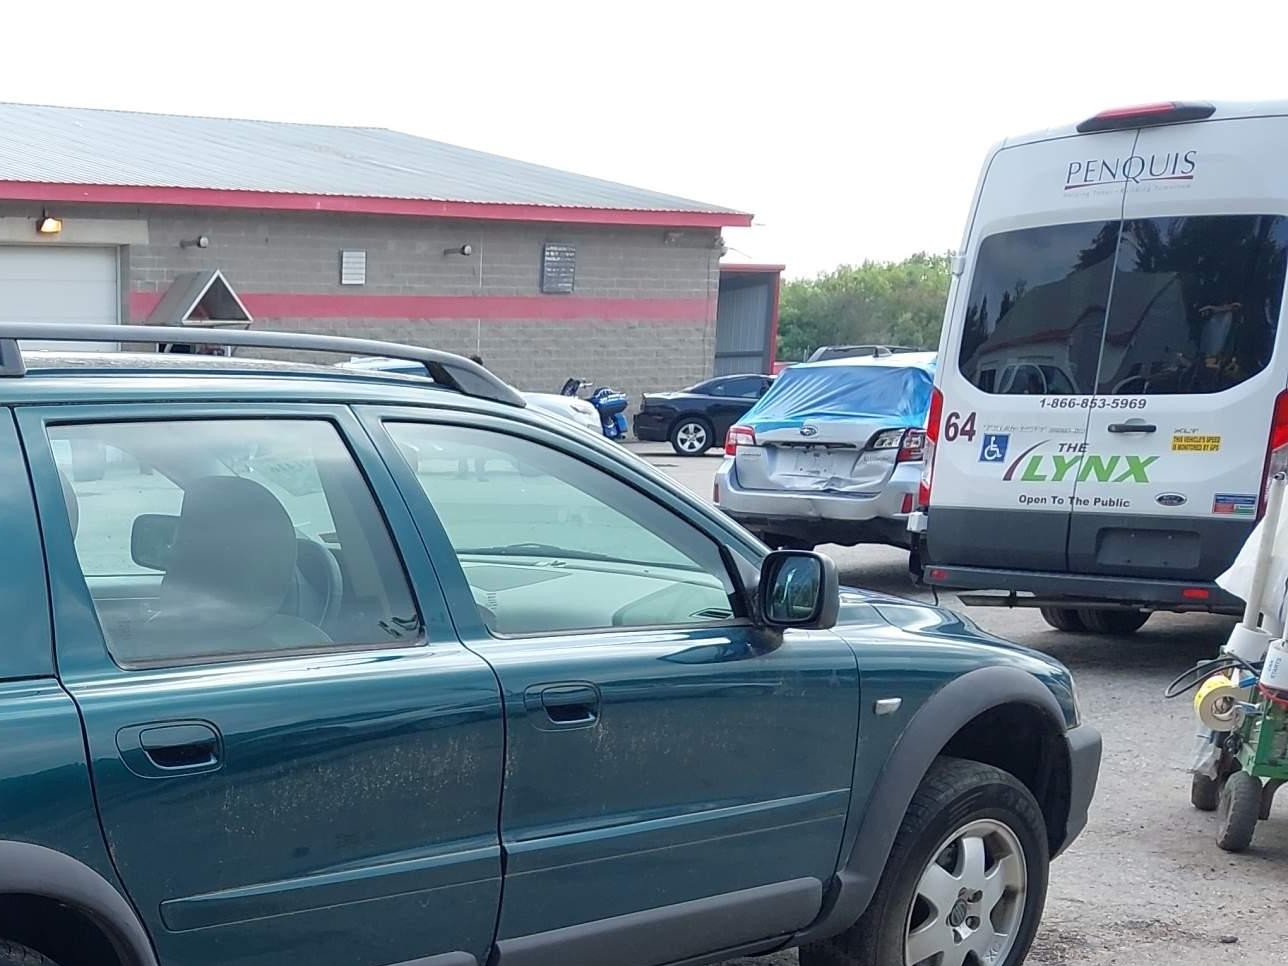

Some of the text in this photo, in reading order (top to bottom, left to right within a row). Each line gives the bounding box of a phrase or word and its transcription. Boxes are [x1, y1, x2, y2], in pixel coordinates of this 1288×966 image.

[1066, 150, 1198, 184] PENQUIS
[1039, 397, 1147, 410] 1-866-853-5969
[944, 411, 977, 442] 64
[1058, 442, 1089, 453] THE
[1021, 455, 1161, 483] LYNX
[1018, 494, 1130, 508] Open To The Public
